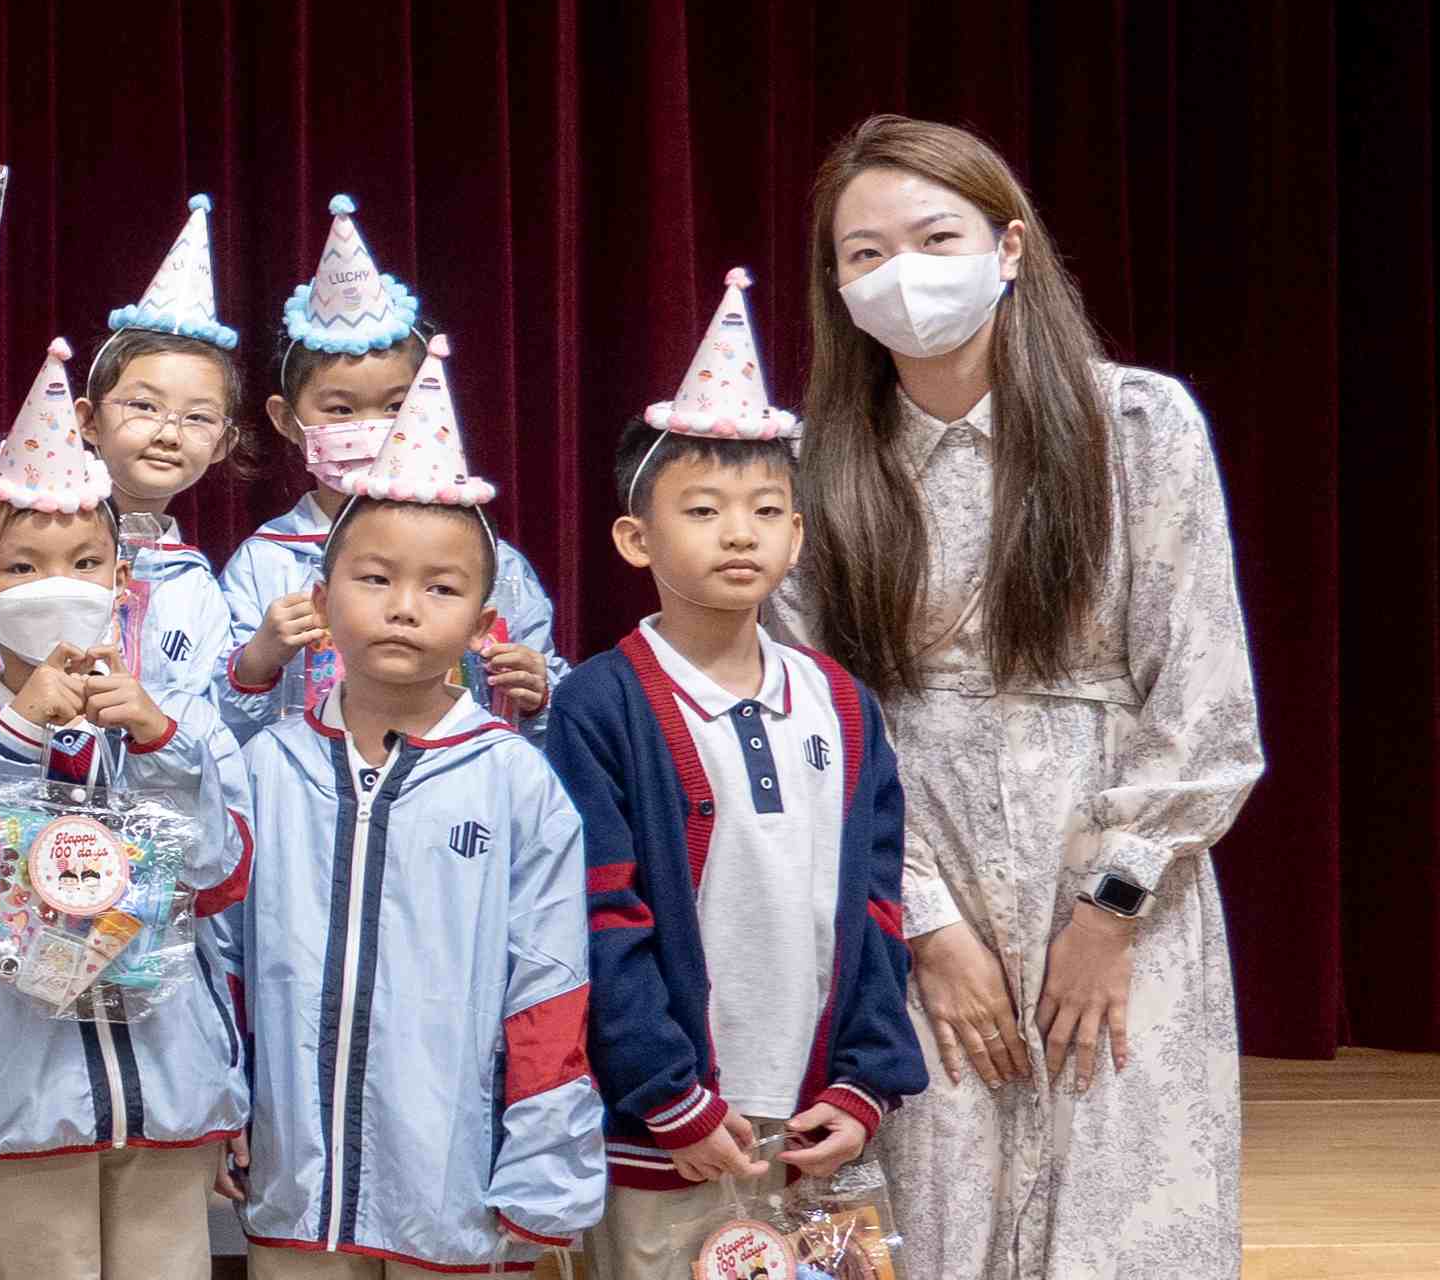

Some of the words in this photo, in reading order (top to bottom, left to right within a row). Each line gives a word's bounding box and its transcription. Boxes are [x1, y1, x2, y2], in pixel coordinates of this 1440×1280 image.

[54, 833, 97, 848] Happy
[49, 846, 72, 859] 100
[77, 847, 108, 860] days
[714, 1231, 756, 1261] Happy
[716, 1254, 737, 1275] 100
[738, 1240, 769, 1264] days
